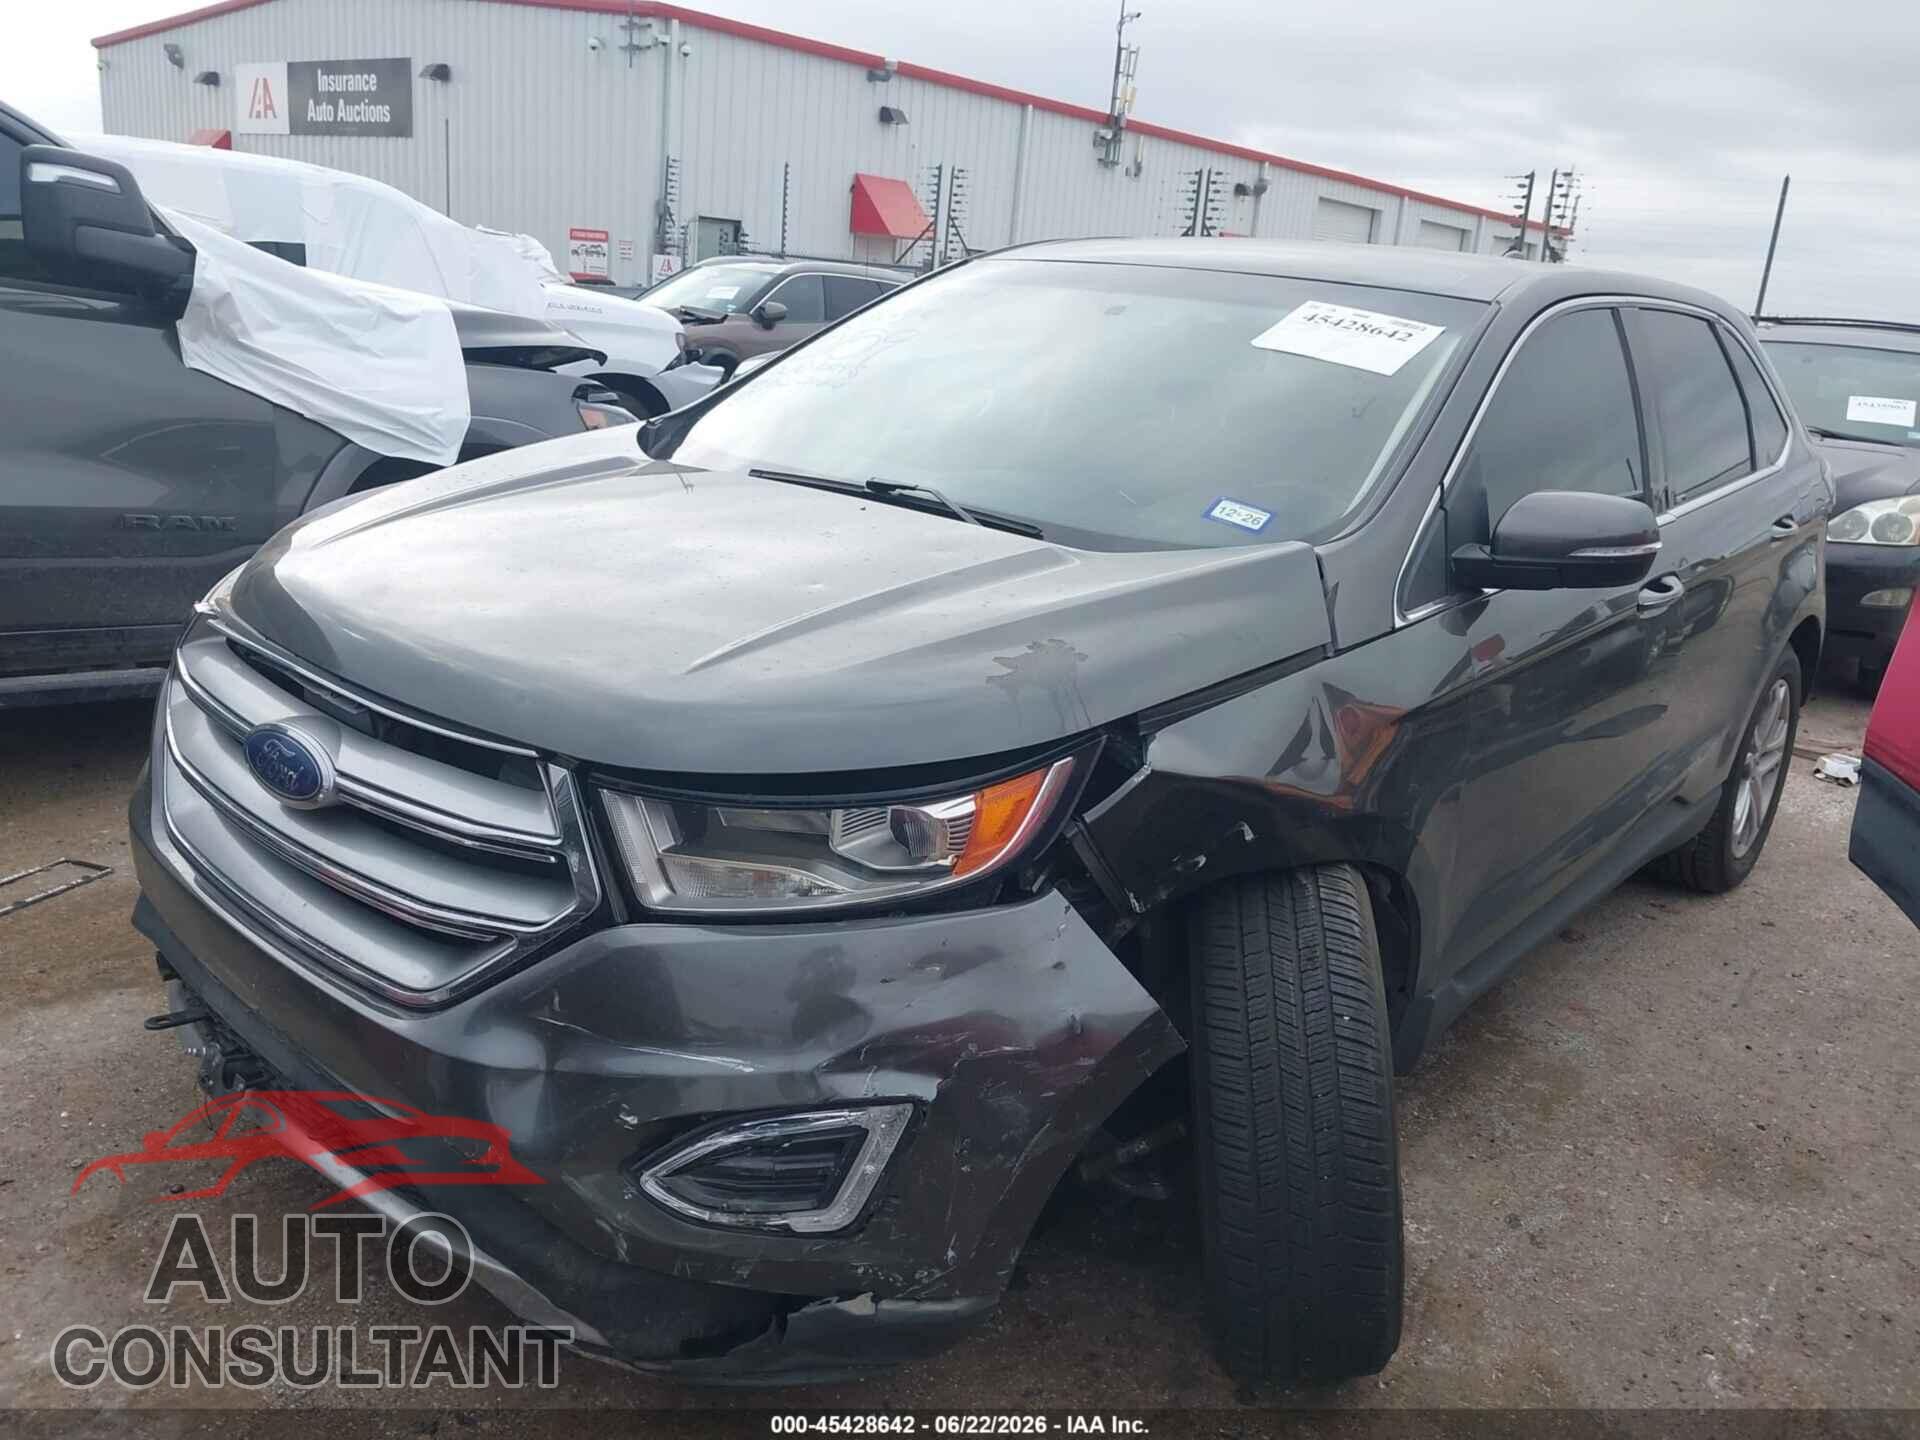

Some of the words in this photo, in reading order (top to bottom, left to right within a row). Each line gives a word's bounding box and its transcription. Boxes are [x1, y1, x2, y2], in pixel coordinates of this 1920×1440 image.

[317, 68, 378, 92] Insurance
[307, 99, 335, 122] Auto
[337, 98, 391, 123] Auctions
[1302, 312, 1413, 342] 45428642
[120, 512, 238, 530] RAM
[256, 738, 306, 792] Ford
